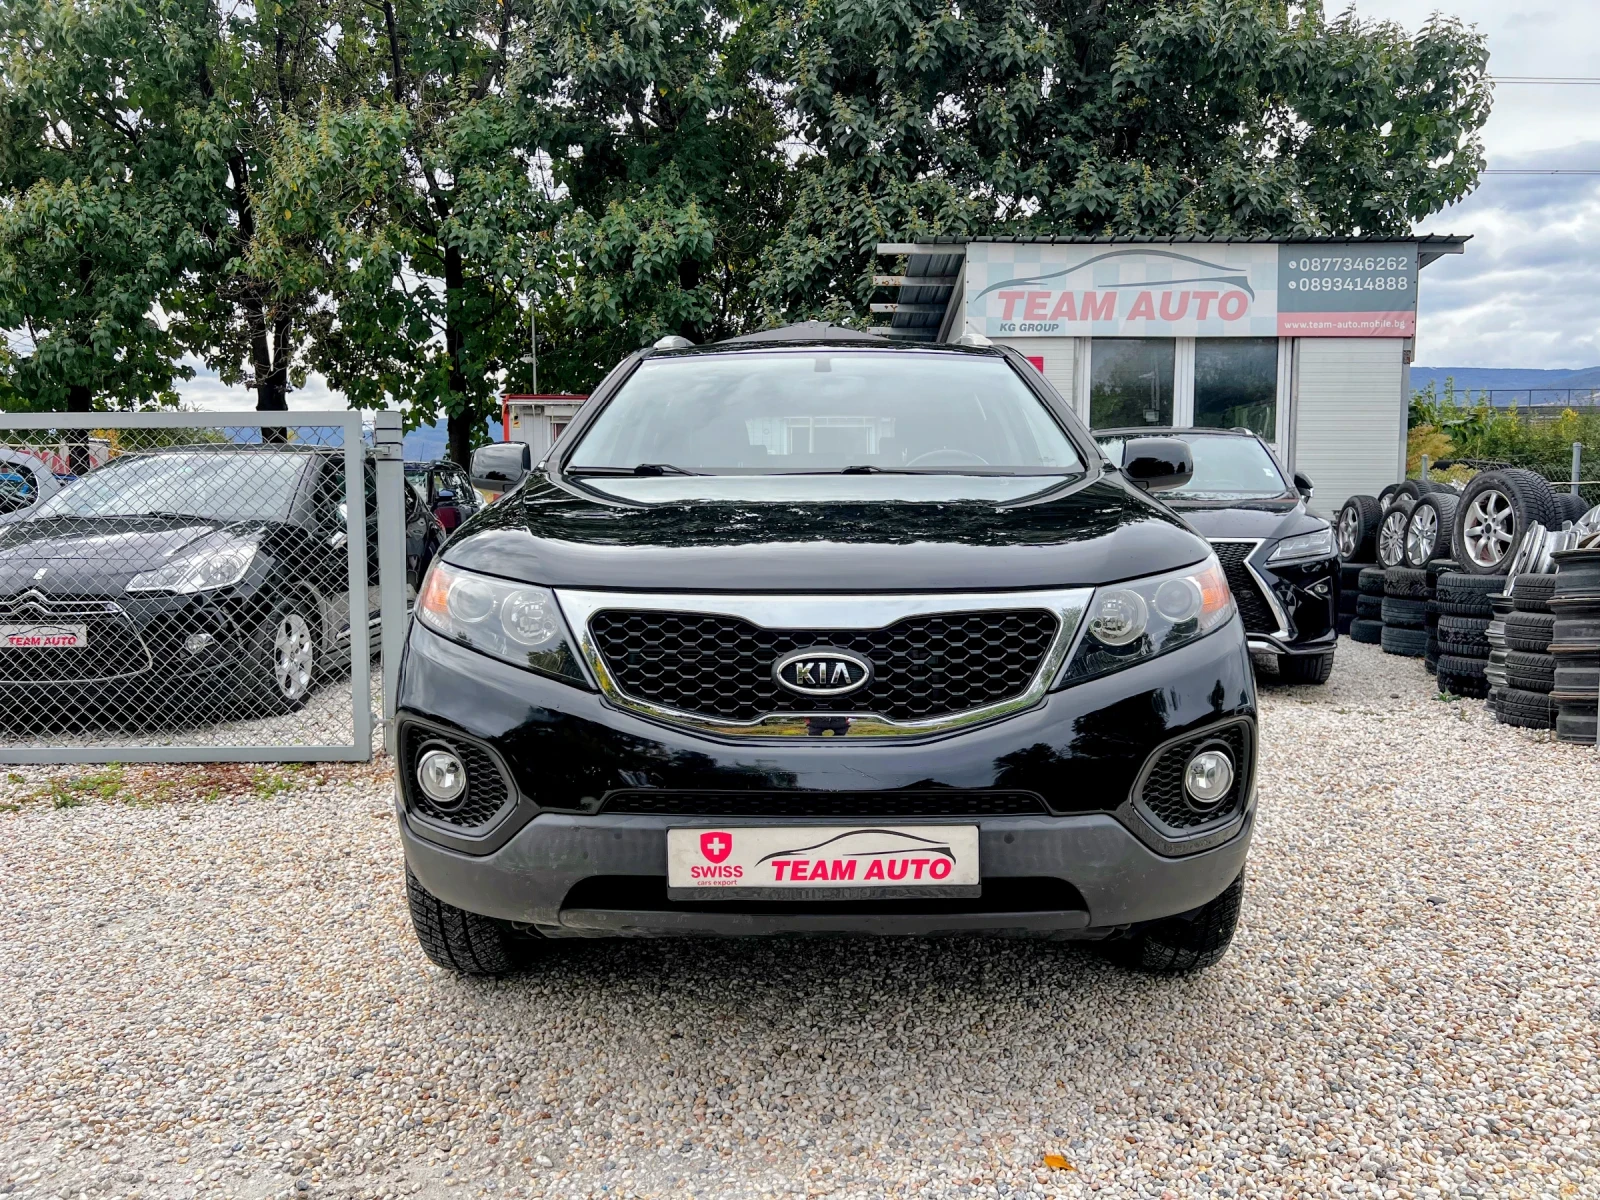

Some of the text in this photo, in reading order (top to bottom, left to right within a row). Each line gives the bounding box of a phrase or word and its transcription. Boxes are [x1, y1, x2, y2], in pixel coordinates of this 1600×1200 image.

[1300, 257, 1408, 271] 0877346262
[1300, 277, 1408, 291] 0893414888
[998, 291, 1249, 321] TEAM AUTO
[999, 323, 1059, 332] KG GROUP
[1284, 319, 1405, 329] www.team-auto.mobile.bg
[8, 636, 77, 646] TEAM AUTO
[795, 662, 852, 684] KIA
[690, 865, 743, 878] SWISS
[771, 858, 951, 881] TEAM AUTO
[713, 879, 738, 887] export
